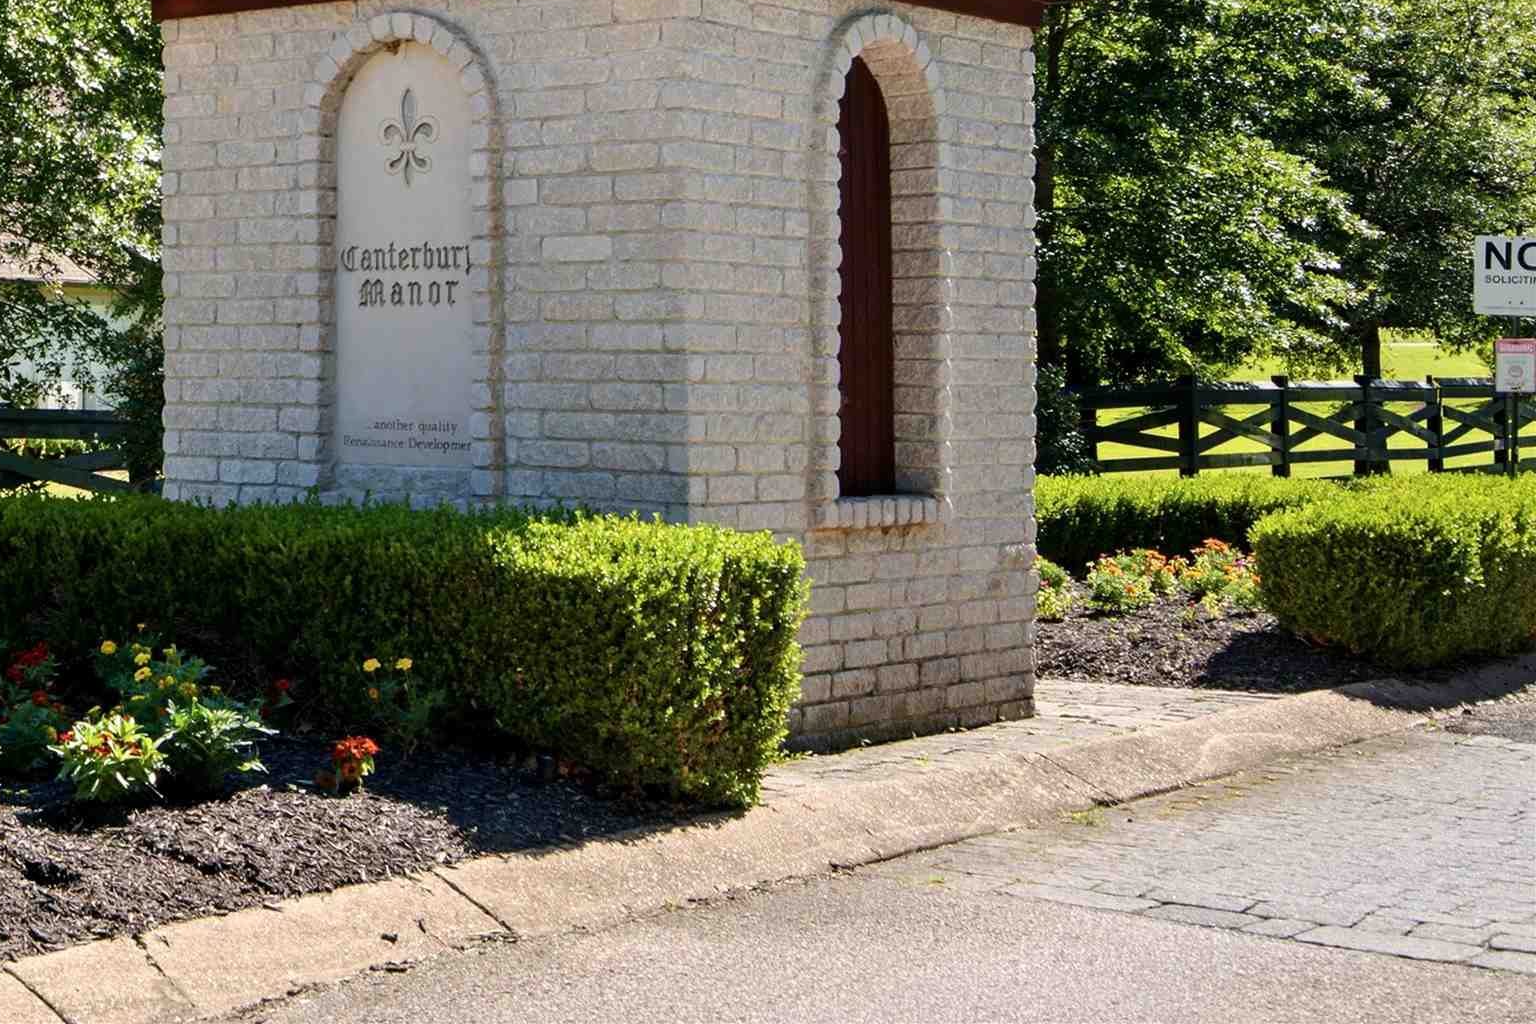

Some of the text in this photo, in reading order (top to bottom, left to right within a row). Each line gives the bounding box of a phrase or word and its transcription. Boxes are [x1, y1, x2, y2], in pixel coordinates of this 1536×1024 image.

[1485, 241, 1536, 271] NO
[1485, 274, 1536, 285] SOLICITI
[359, 278, 459, 307] Manor
[417, 420, 458, 435] quality
[408, 437, 472, 454] Developmen
